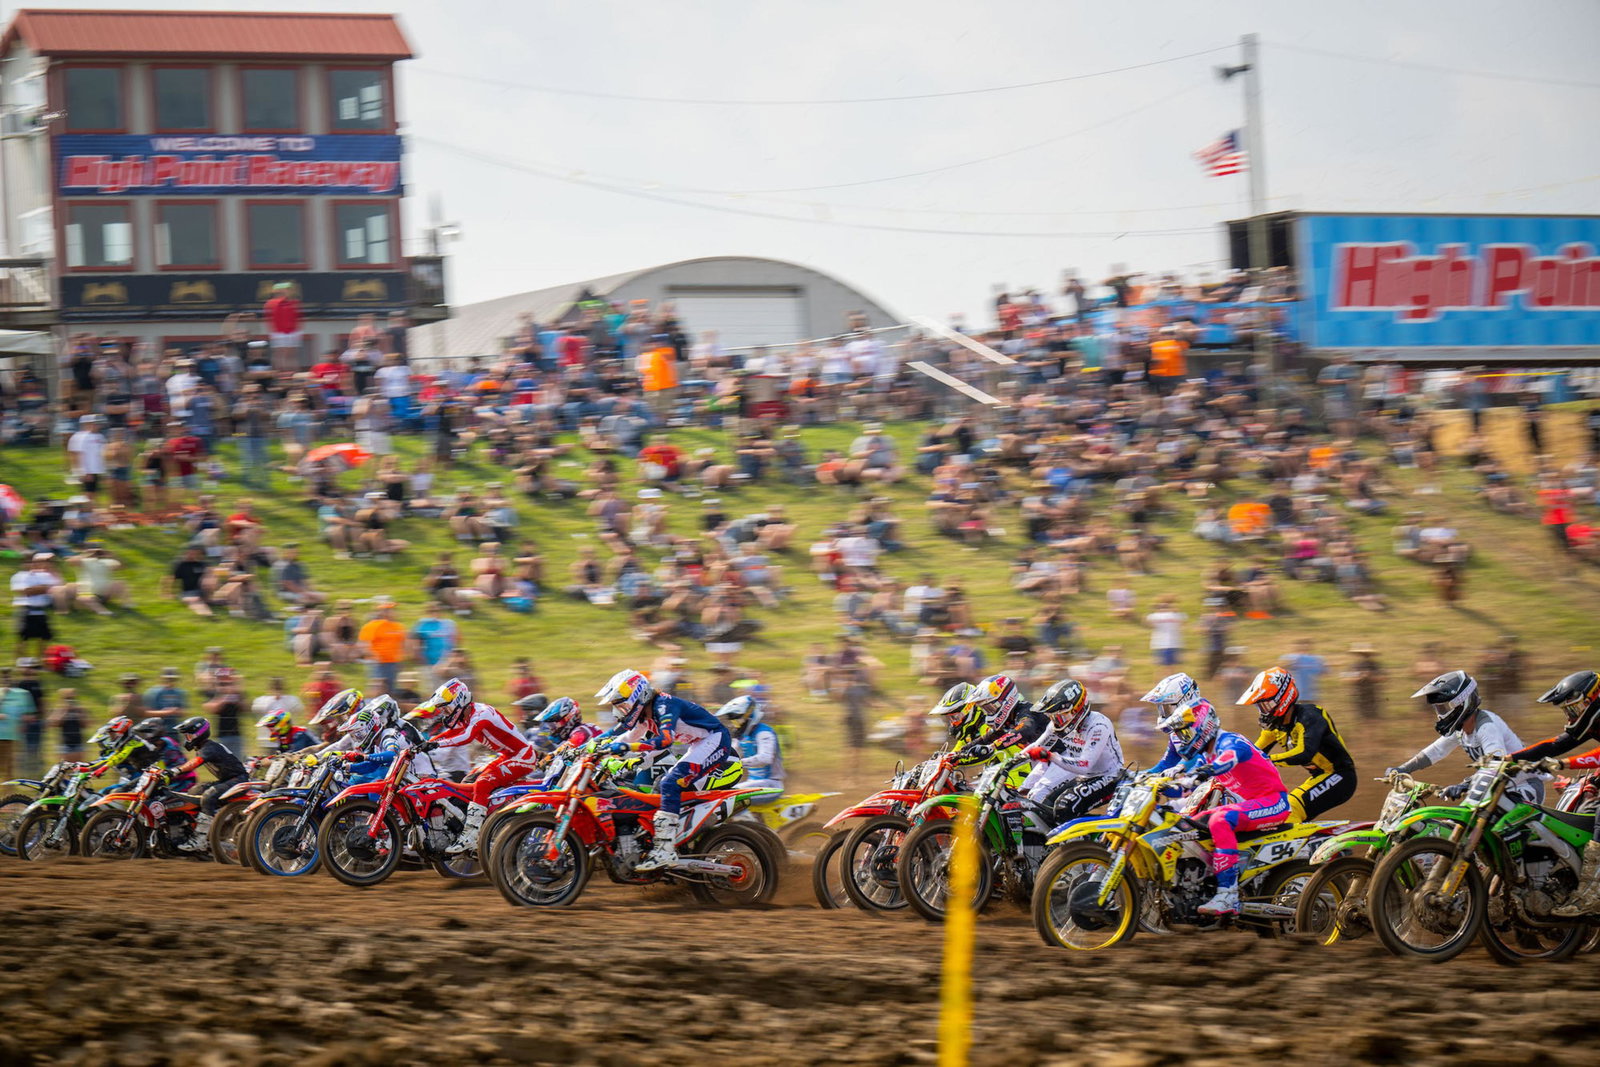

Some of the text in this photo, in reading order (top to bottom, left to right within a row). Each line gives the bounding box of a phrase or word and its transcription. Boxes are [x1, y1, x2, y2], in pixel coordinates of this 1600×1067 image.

[150, 137, 315, 151] WELCOME TO
[63, 155, 399, 193] High Point Raceway
[1330, 241, 1472, 324] High
[1064, 684, 1080, 700] 81
[702, 749, 724, 769] THOR
[1271, 842, 1294, 861] 94
